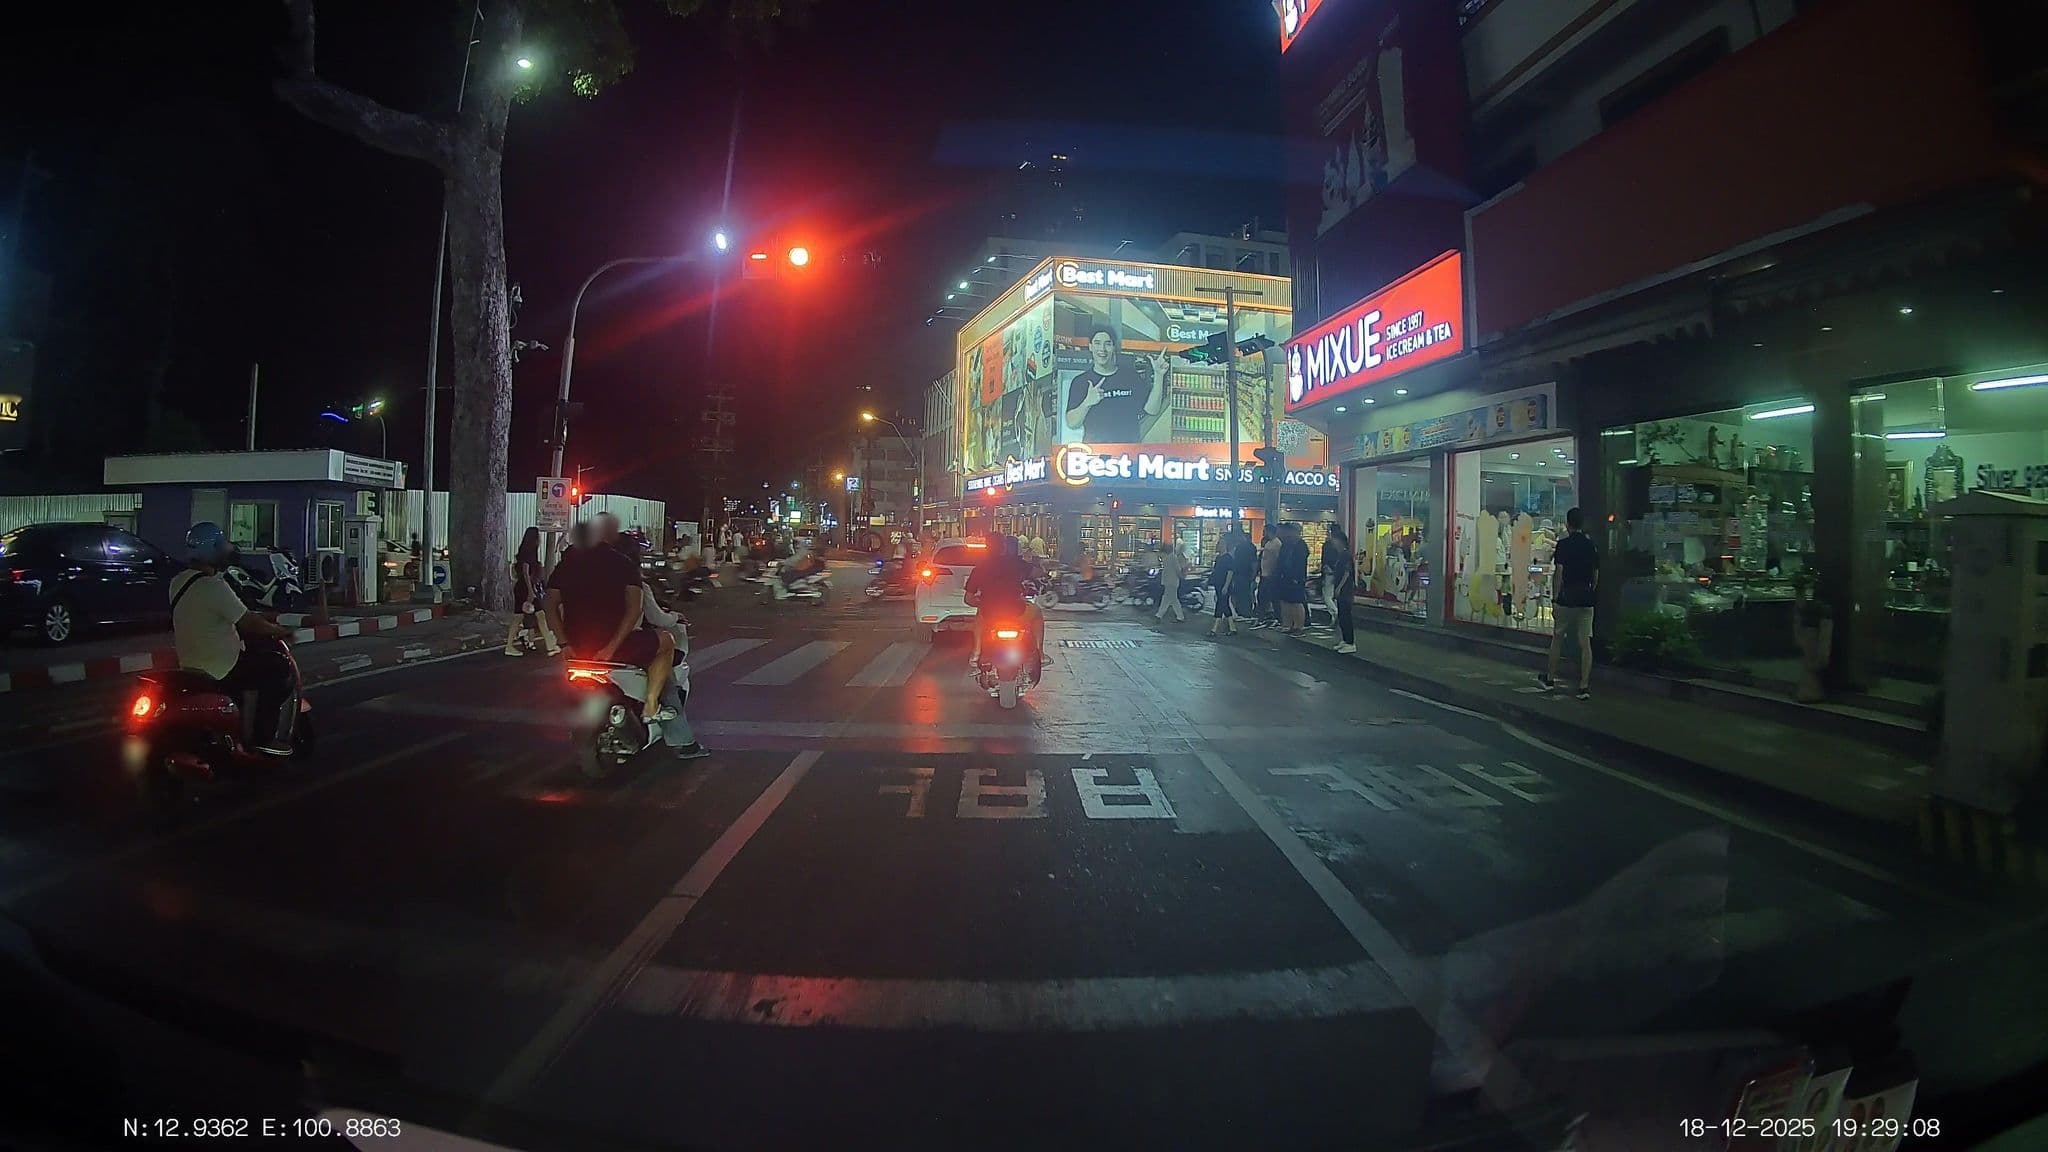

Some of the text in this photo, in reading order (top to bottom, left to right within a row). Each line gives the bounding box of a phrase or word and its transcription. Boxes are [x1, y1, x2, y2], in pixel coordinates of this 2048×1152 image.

[1063, 264, 1154, 290] Best Mart
[1170, 327, 1197, 340] Best
[1386, 319, 1408, 341] SINCE
[1386, 321, 1452, 361] ICE CREAM & TEA
[1306, 310, 1382, 391] MIXUE
[1067, 451, 1132, 479] Best
[1138, 453, 1210, 481] Mart
[1195, 505, 1218, 517] Best
